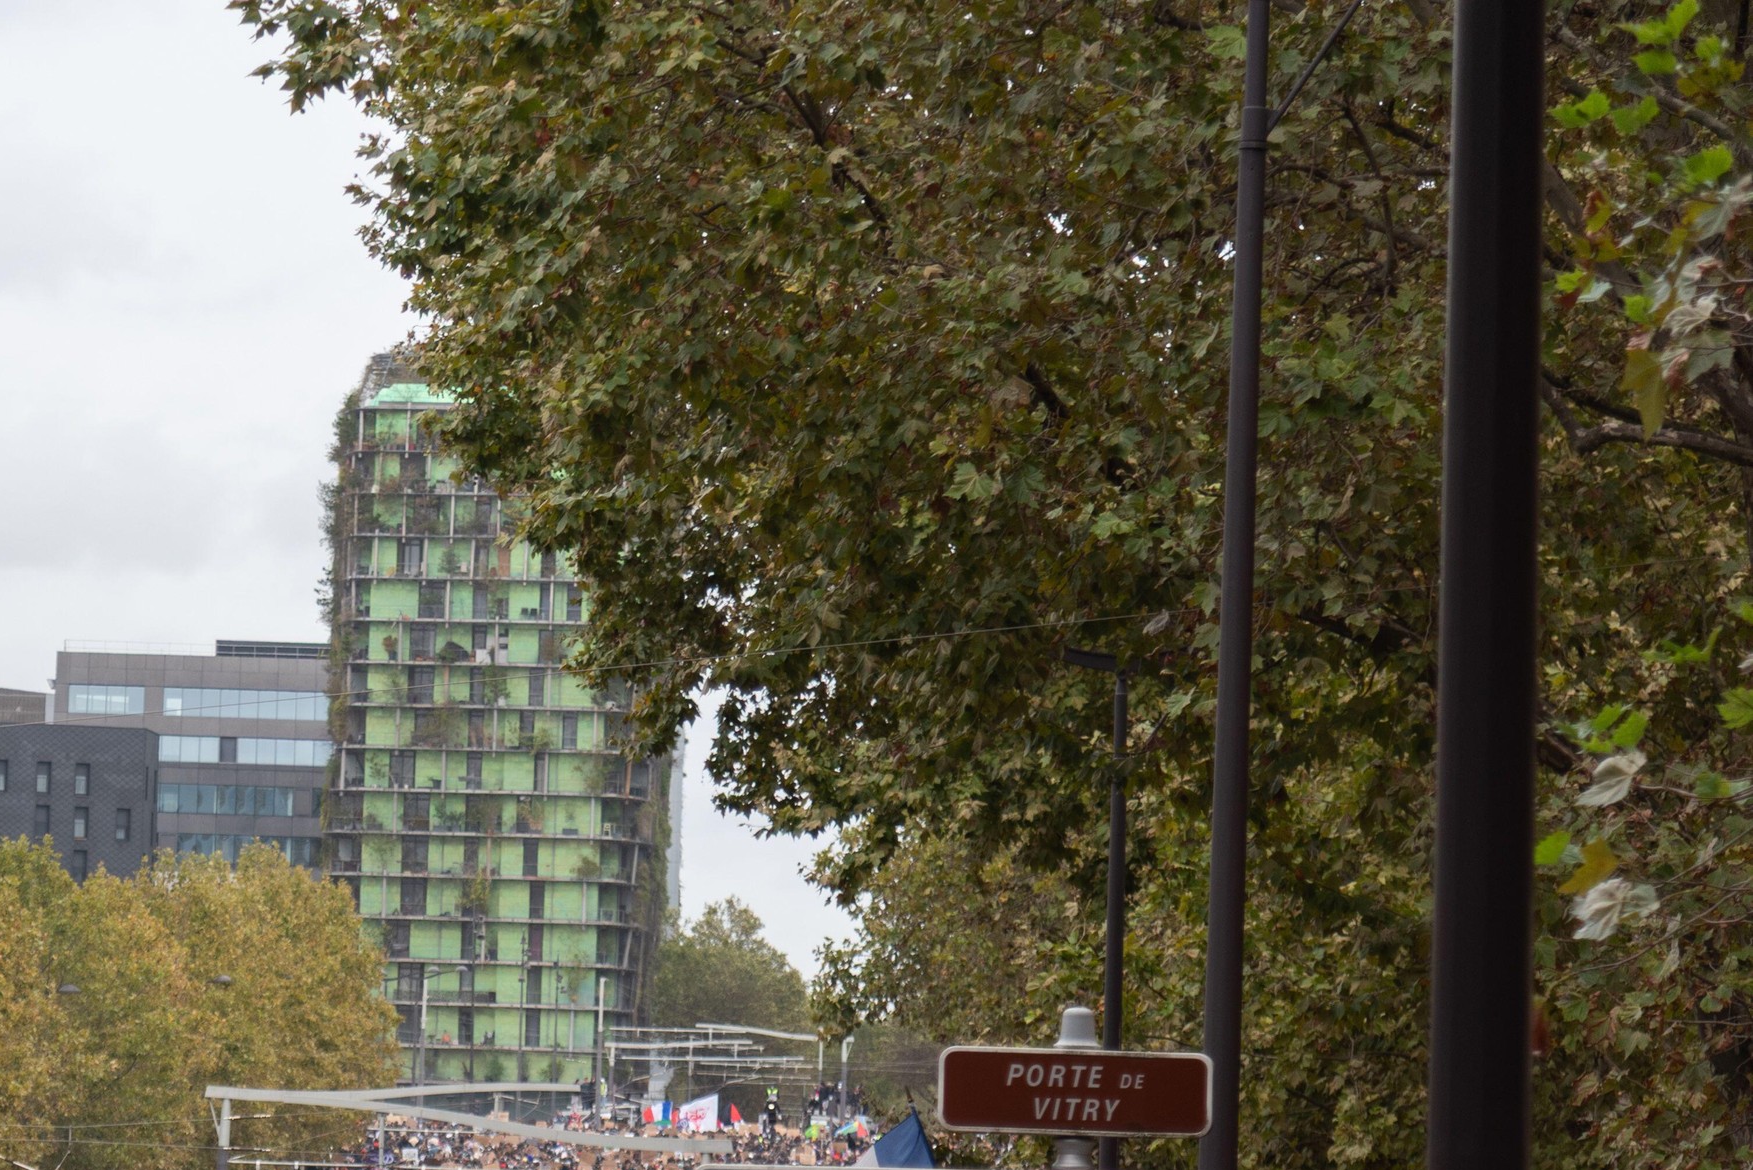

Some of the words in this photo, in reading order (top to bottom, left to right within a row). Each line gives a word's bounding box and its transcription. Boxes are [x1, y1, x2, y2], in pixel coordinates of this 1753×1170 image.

[1006, 1064, 1103, 1088] PORTE
[1119, 1074, 1145, 1089] DE
[1034, 1098, 1121, 1122] VITRY
